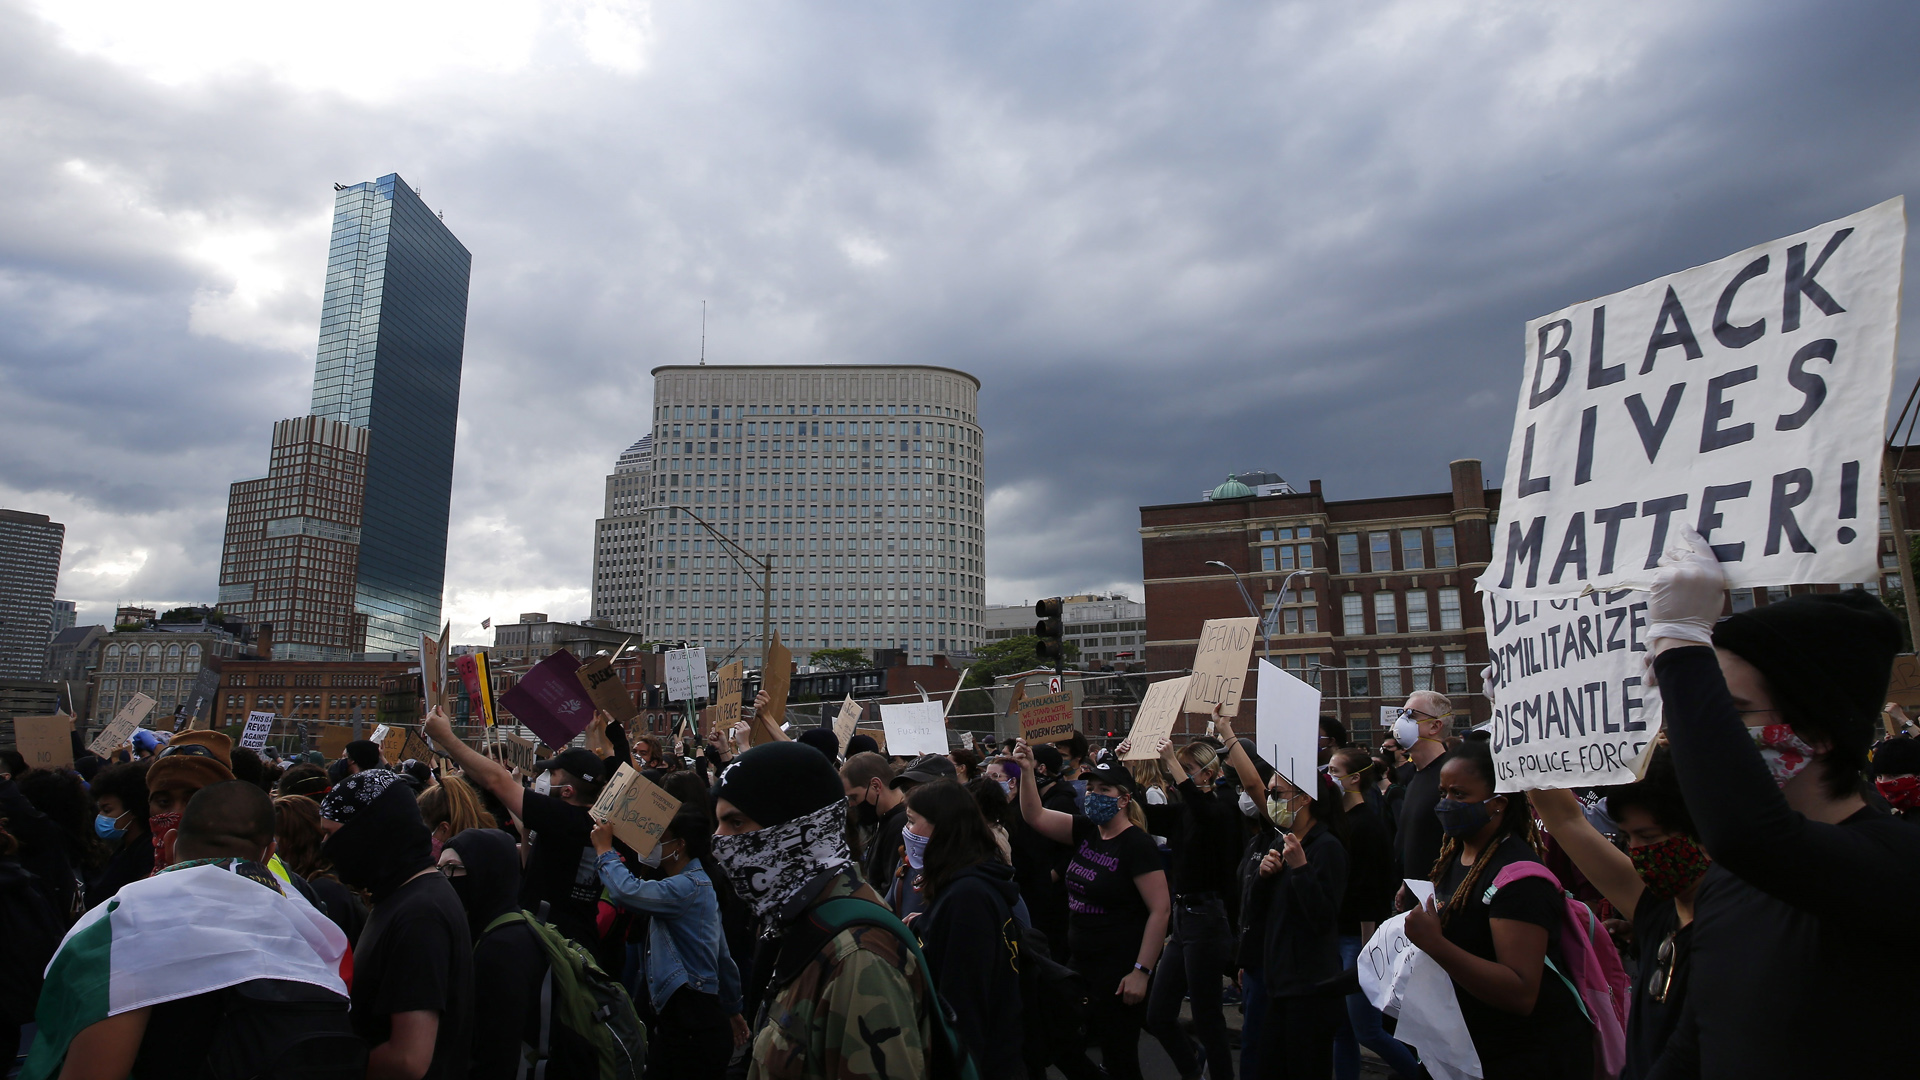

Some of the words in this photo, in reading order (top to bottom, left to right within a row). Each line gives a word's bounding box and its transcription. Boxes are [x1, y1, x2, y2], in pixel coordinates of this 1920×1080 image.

[1529, 227, 1855, 409] BLACK
[1518, 338, 1837, 498] LIVES
[1498, 460, 1860, 589] MATTER!
[1200, 625, 1250, 654] DEFUND
[1489, 602, 1648, 689] DEMILITARIZE
[587, 665, 616, 689] SILENCE
[1190, 671, 1239, 706] POLICE
[1055, 693, 1070, 703] LIVES
[1145, 681, 1186, 712] BLACK
[723, 702, 738, 720] PEACE
[1022, 711, 1031, 719] WE
[1033, 707, 1050, 716] STAND
[1051, 704, 1066, 713] WITH
[1022, 719, 1034, 728] YOU
[1036, 713, 1060, 725] AGAINST
[1062, 711, 1073, 720] THE
[1137, 708, 1174, 733] LIVES
[1493, 676, 1646, 754] DISMANTLE
[243, 732, 268, 740] AGAINST
[246, 722, 271, 732] REVOLT
[1025, 726, 1050, 740] MODERN
[1051, 723, 1074, 736] GESTAPO
[242, 740, 265, 748] RACISM
[37, 751, 52, 762] NO
[1497, 761, 1517, 781] U.S.
[1519, 750, 1572, 777] POLICE
[1078, 839, 1119, 872] Resisting
[1066, 859, 1097, 881] yrants
